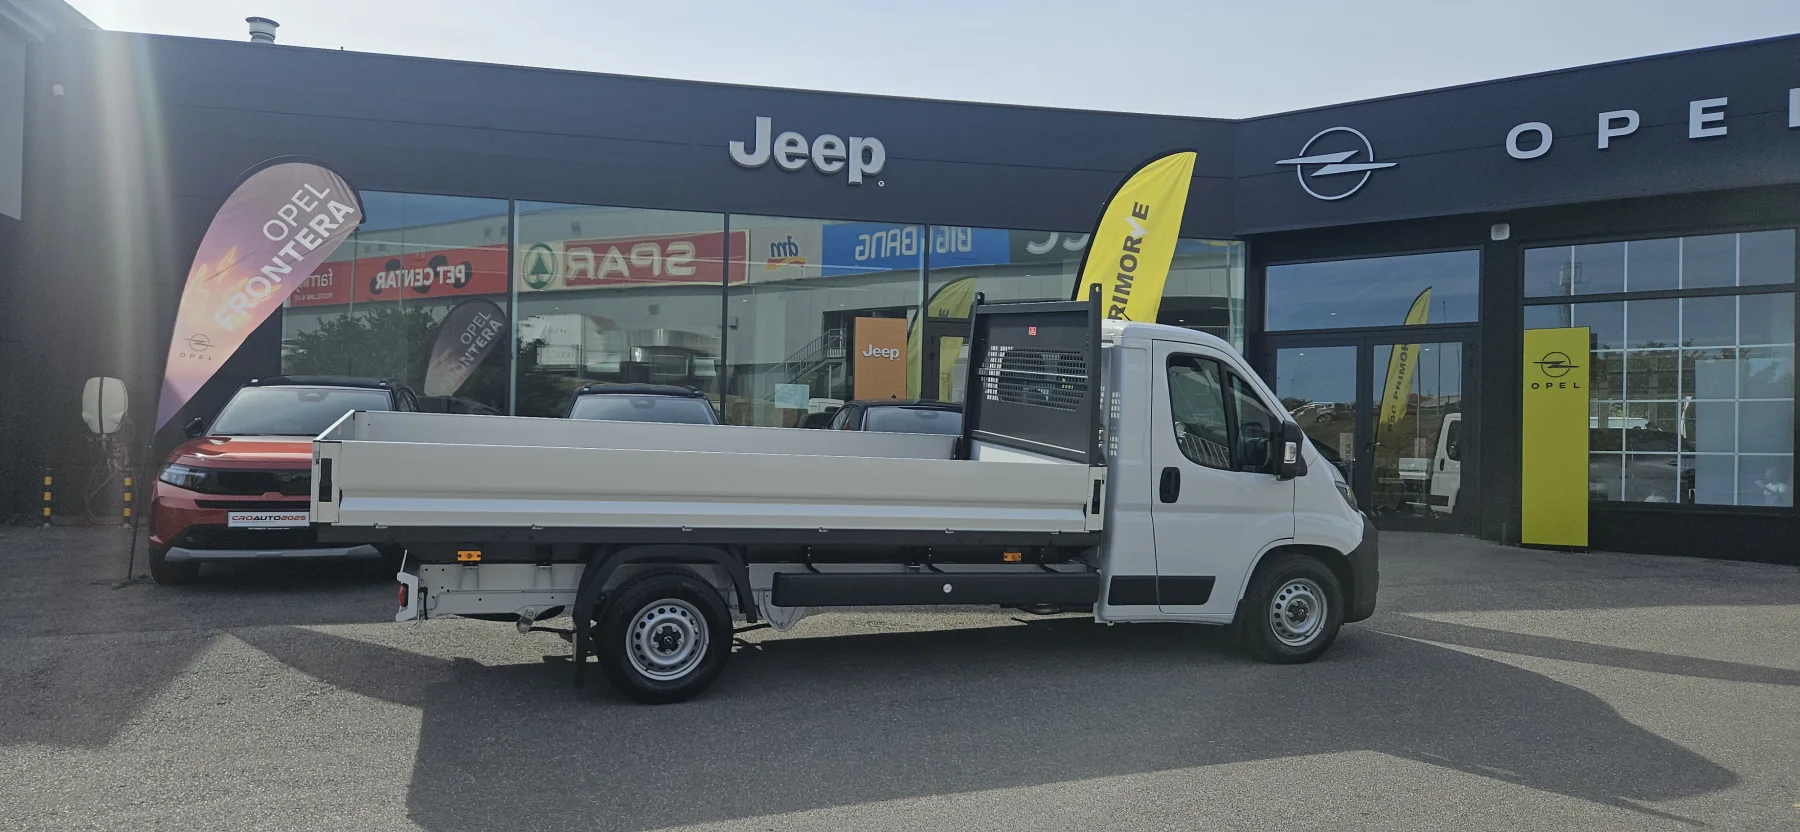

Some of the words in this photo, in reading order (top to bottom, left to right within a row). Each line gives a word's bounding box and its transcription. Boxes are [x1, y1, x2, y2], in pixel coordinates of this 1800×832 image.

[1505, 87, 1800, 160] OPE
[729, 116, 886, 186] Jeep
[262, 183, 331, 241] OPEL
[213, 200, 355, 332] FRONTERA
[460, 312, 491, 344] OPEL
[180, 352, 212, 361] OPEL
[862, 344, 900, 360] Jeep
[1531, 382, 1580, 390] OPEL
